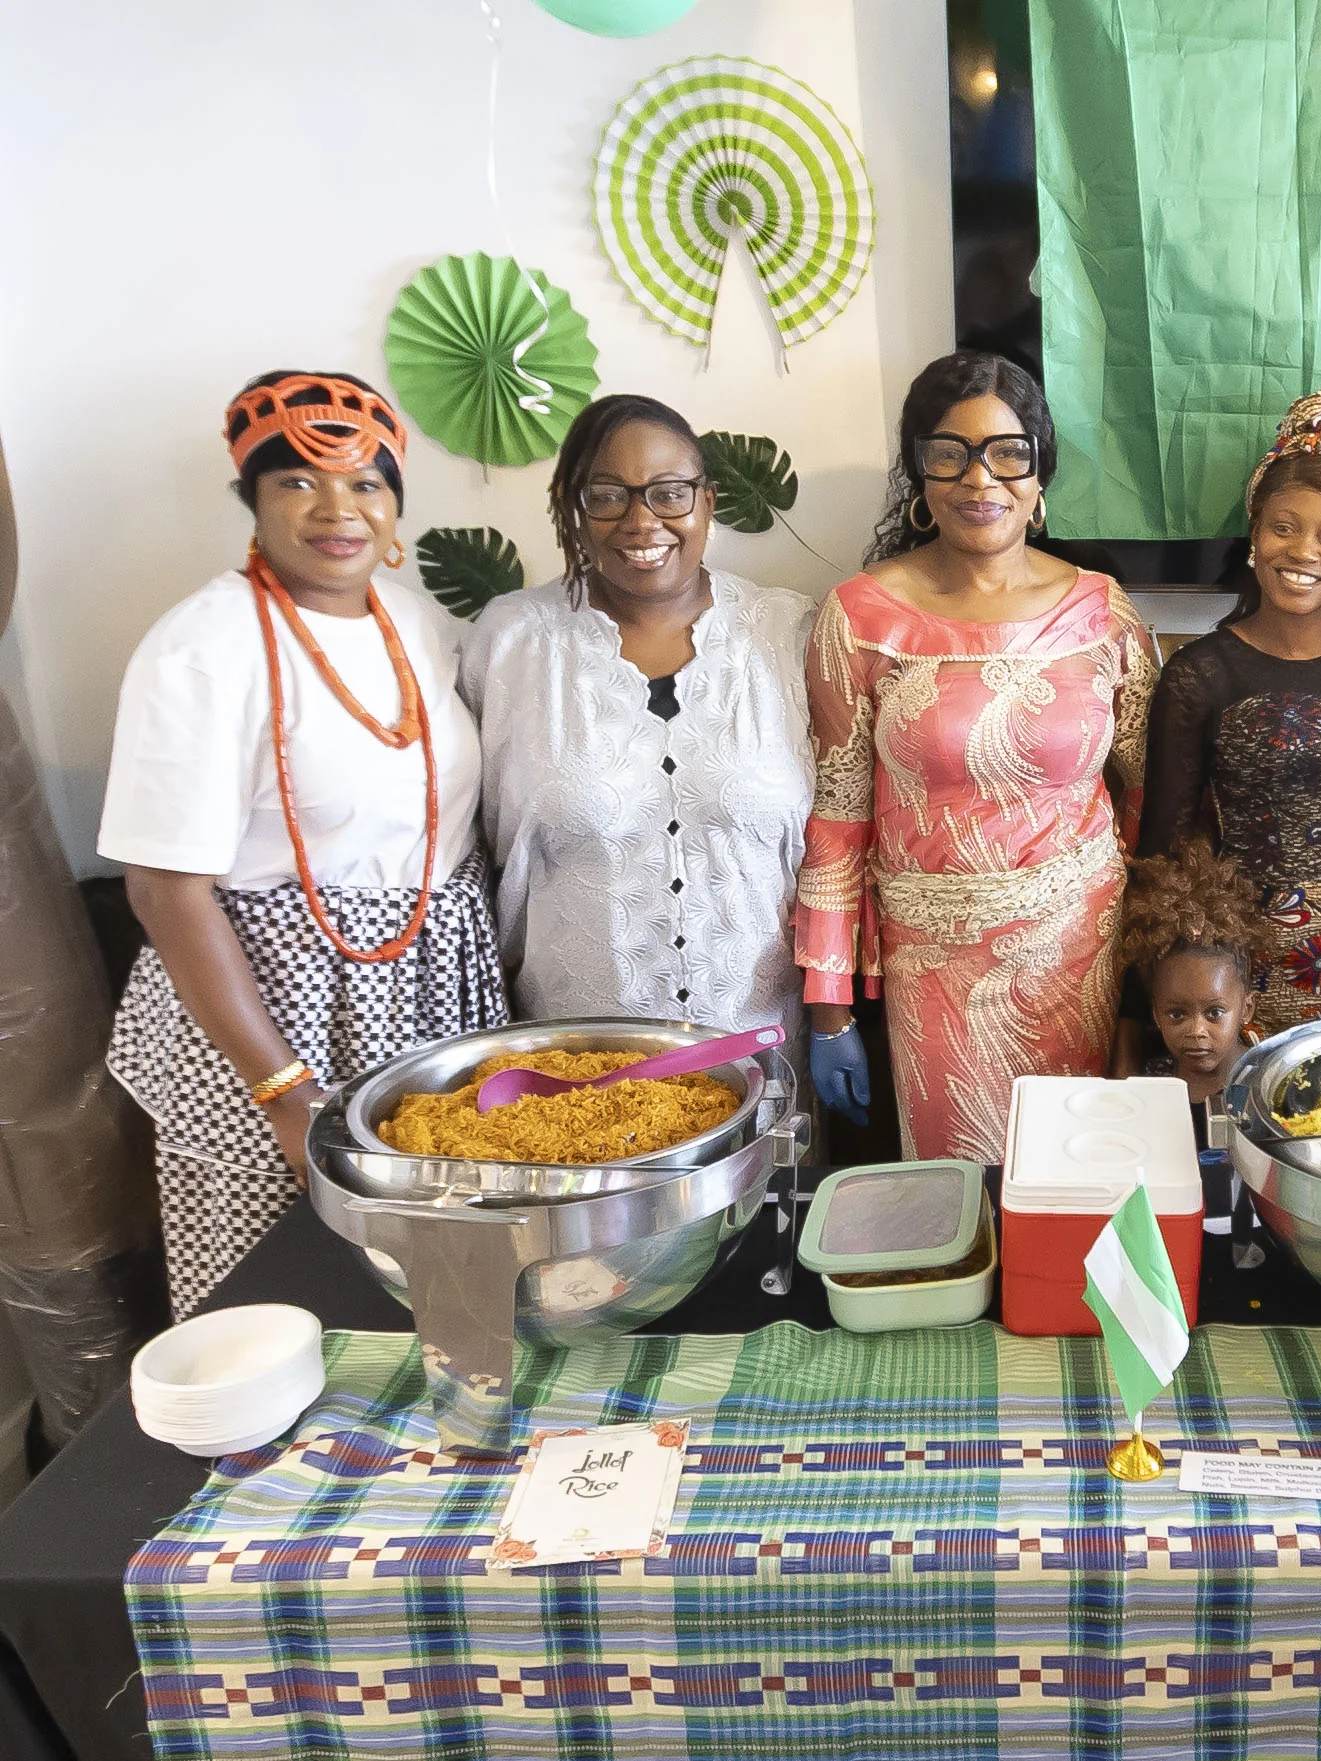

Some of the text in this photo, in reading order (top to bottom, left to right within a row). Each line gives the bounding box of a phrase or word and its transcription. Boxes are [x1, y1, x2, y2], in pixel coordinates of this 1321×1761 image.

[1204, 1459, 1236, 1468] FOOD
[1238, 1461, 1262, 1469] MAY
[1265, 1463, 1314, 1472] CONTAIN
[558, 1475, 619, 1499] Rice
